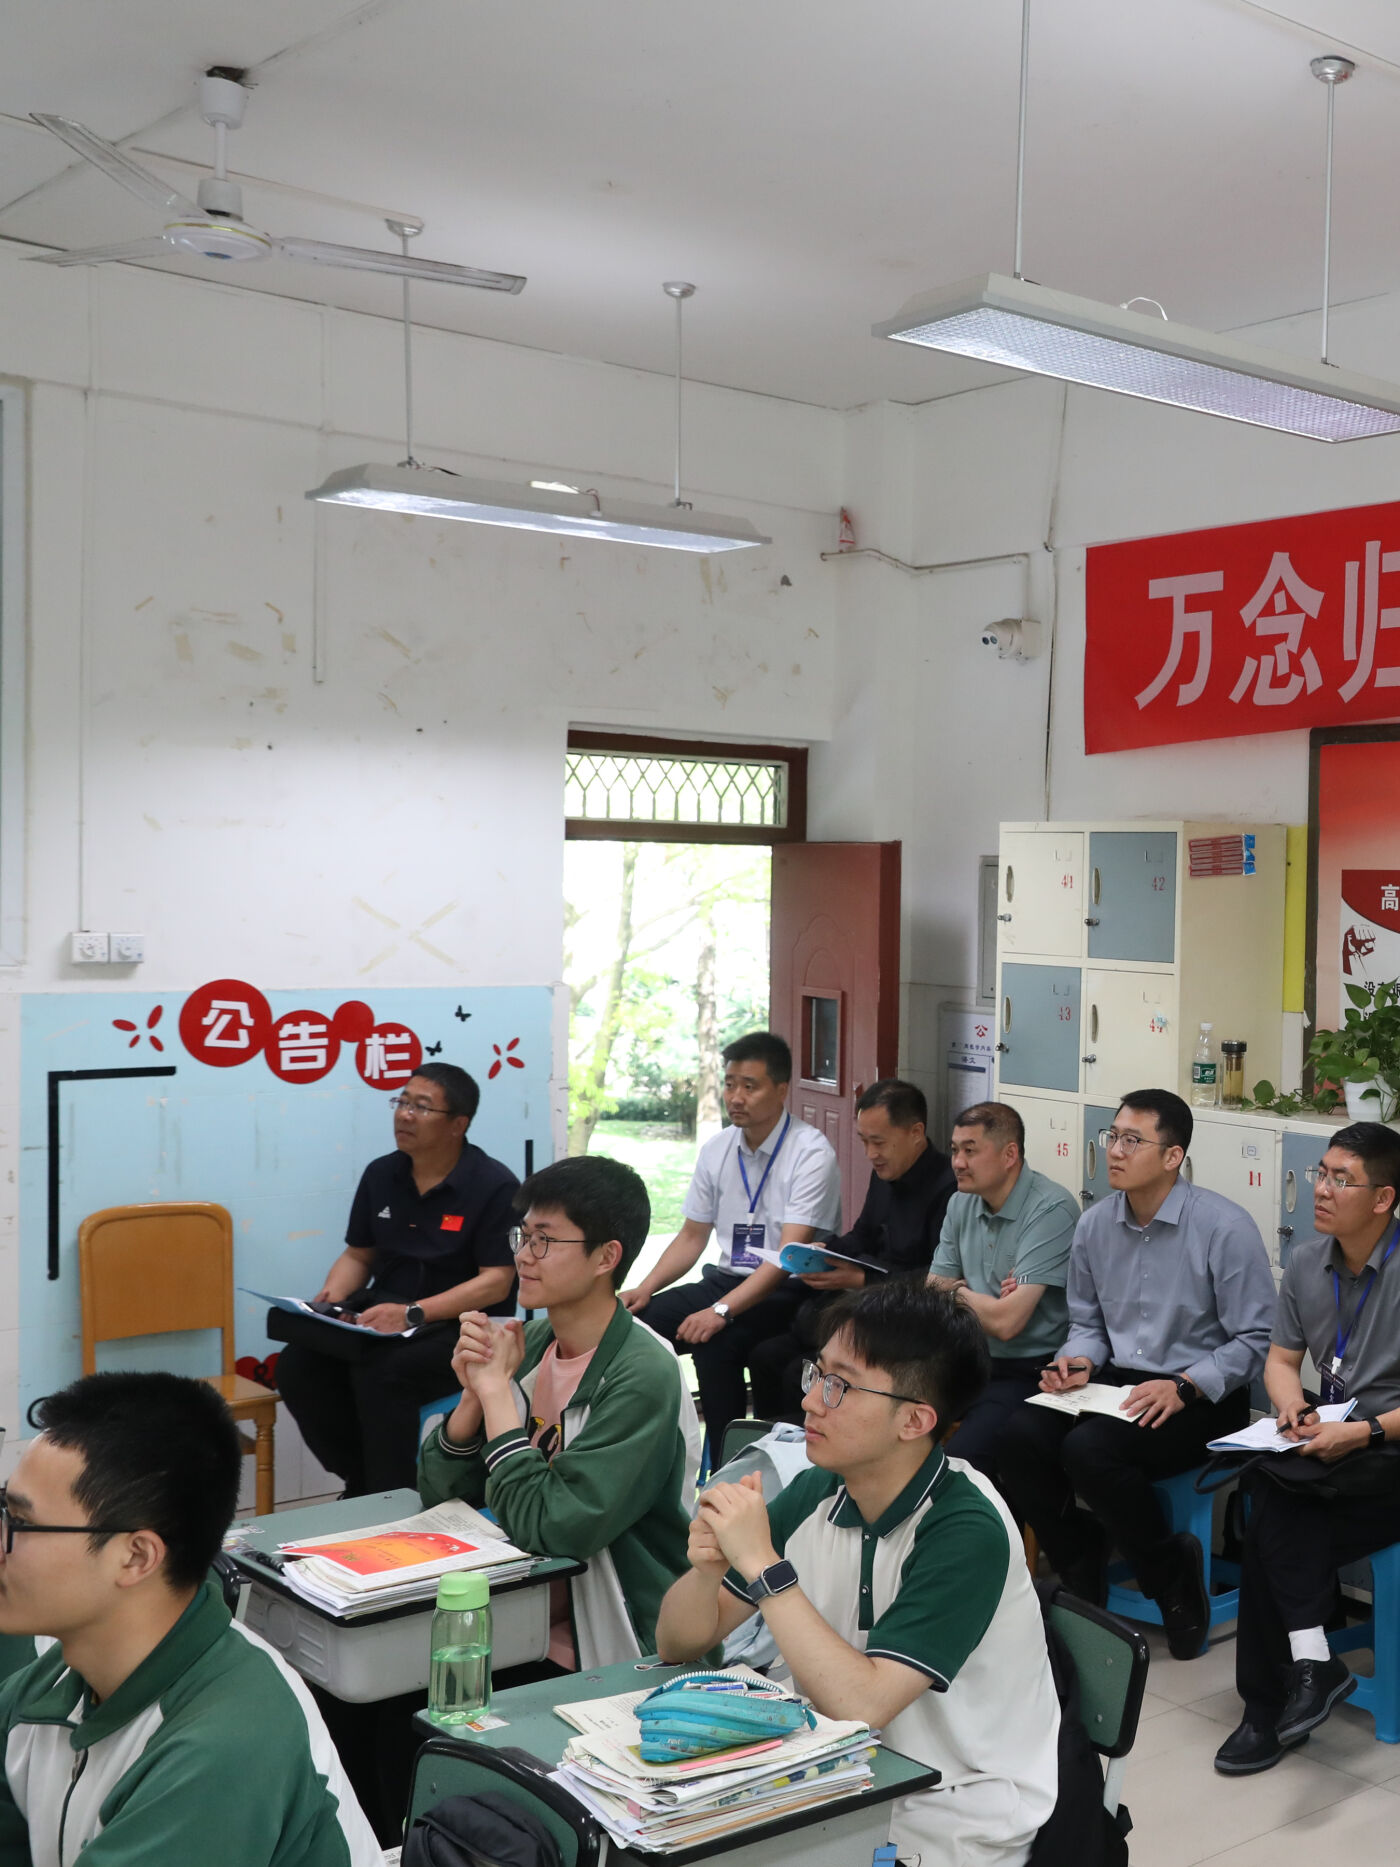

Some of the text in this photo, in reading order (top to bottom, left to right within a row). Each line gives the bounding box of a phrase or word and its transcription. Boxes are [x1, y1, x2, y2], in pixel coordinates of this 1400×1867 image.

[1061, 874, 1074, 888] 41
[1152, 876, 1166, 891] 42
[201, 1000, 412, 1080] 公告栏
[1249, 1170, 1262, 1187] 11
